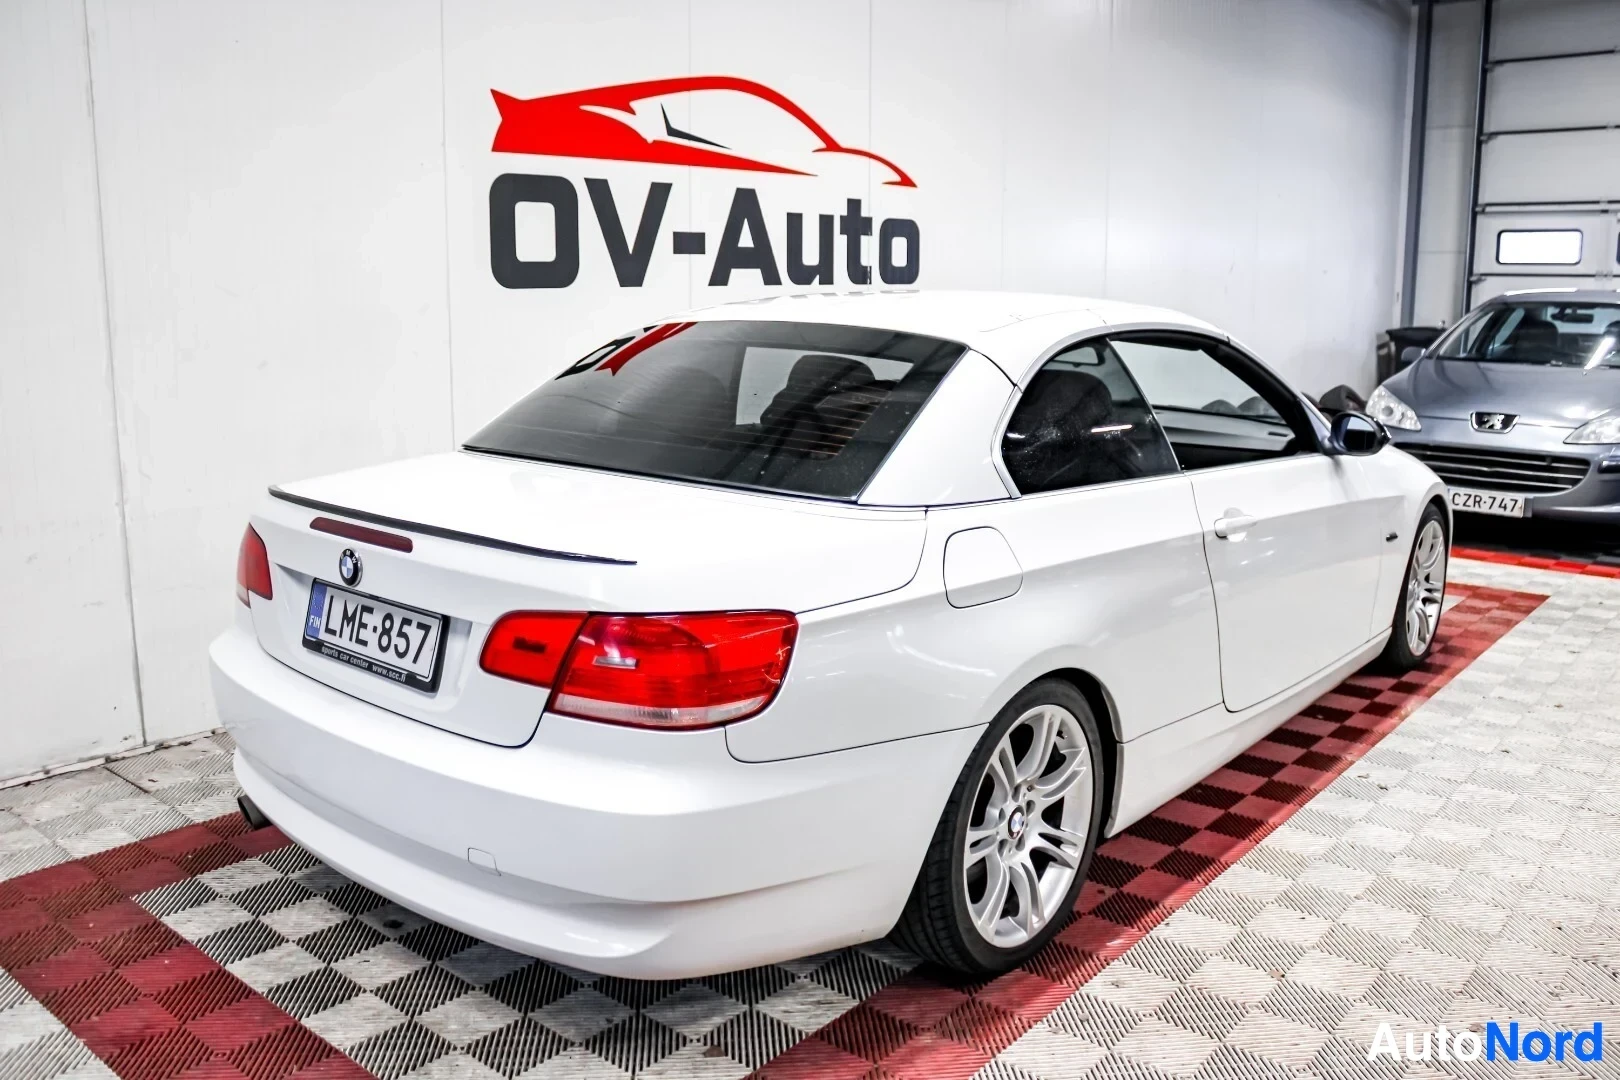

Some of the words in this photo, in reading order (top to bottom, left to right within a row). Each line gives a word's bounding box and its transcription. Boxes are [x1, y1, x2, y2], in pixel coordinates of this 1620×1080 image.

[489, 173, 920, 289] OV-Auto
[1452, 492, 1519, 513] CZR-747
[309, 615, 321, 629] FIN
[324, 595, 432, 665] LME-857
[321, 646, 338, 656] sports
[340, 653, 349, 661] car
[350, 657, 369, 669] center
[372, 664, 406, 683] www.scc.fi
